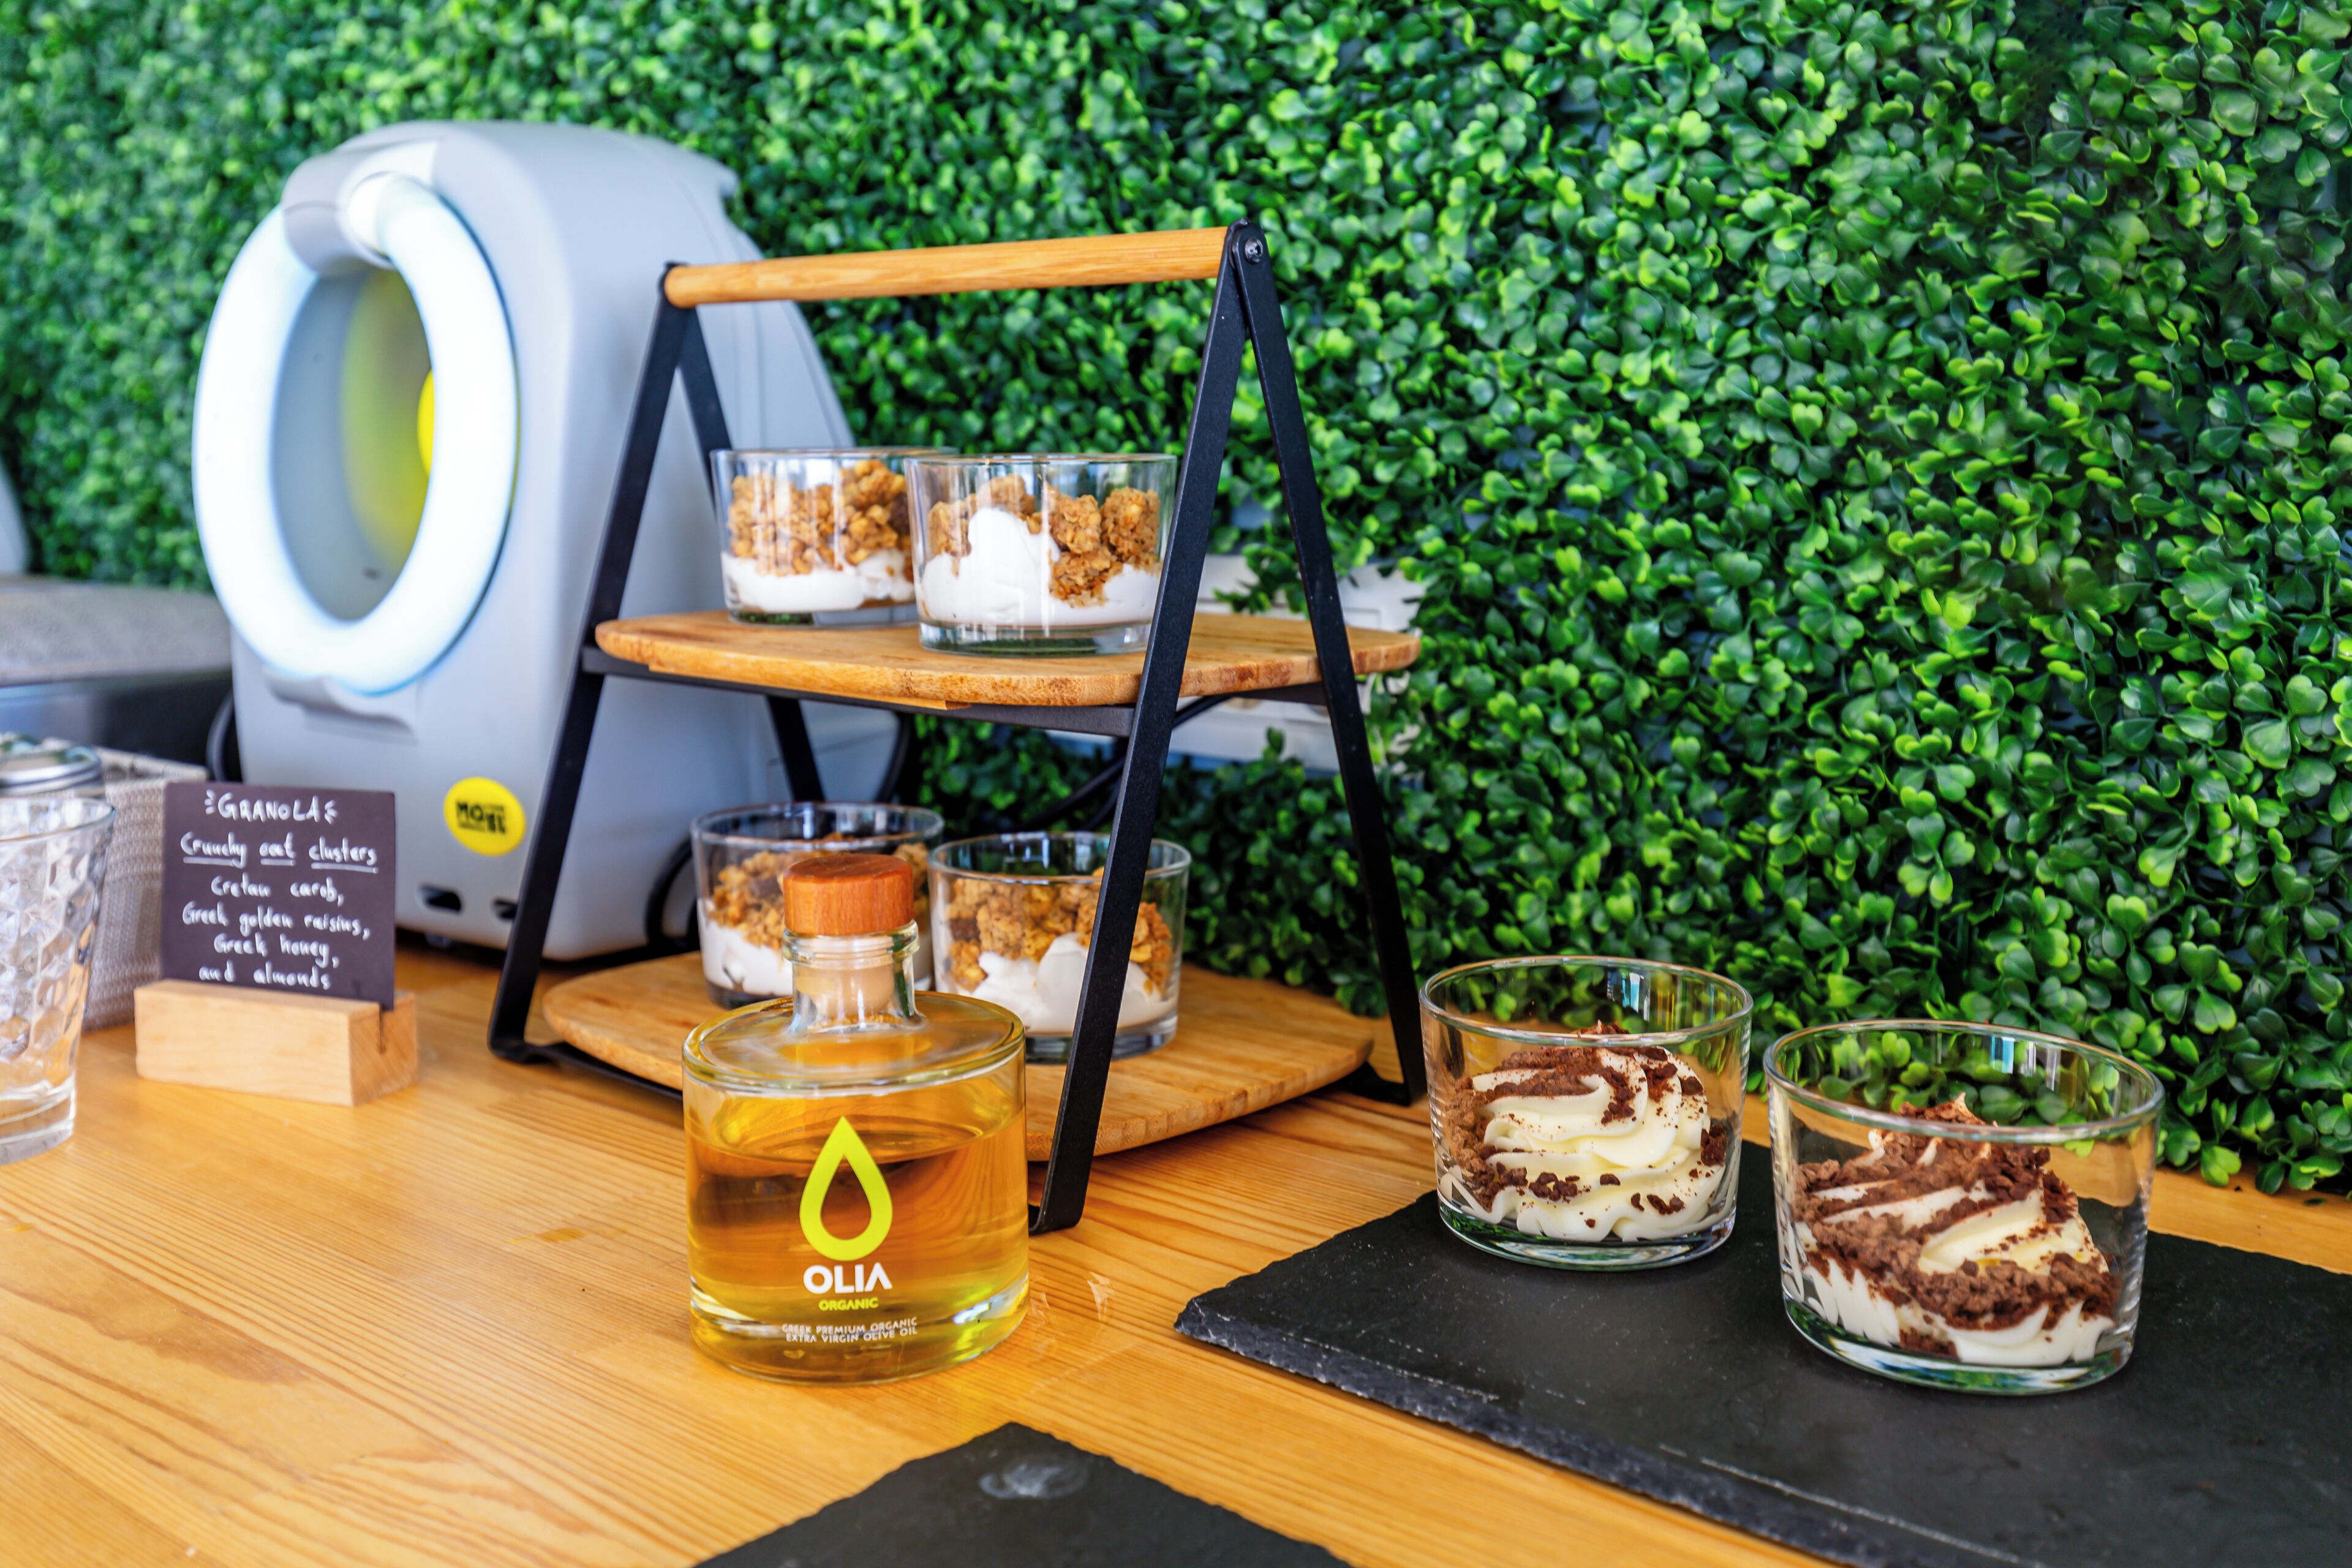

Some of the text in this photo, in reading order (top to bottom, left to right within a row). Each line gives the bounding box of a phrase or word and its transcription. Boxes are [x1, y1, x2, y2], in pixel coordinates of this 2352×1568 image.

[218, 793, 320, 822] GRANOLA
[181, 832, 377, 869] Crunchy oat clusters
[211, 873, 271, 897] Cretan
[183, 901, 370, 940] Greek golden raisins,
[214, 933, 339, 968] Greek honey,
[199, 960, 331, 990] and almonds
[803, 1262, 892, 1294] OLIA
[818, 1297, 879, 1311] ORGANIC
[782, 1317, 918, 1335] GREEK PREMIUM ORGANIC
[786, 1326, 918, 1343] EXTRA VIRGIN OLIVE OIL
